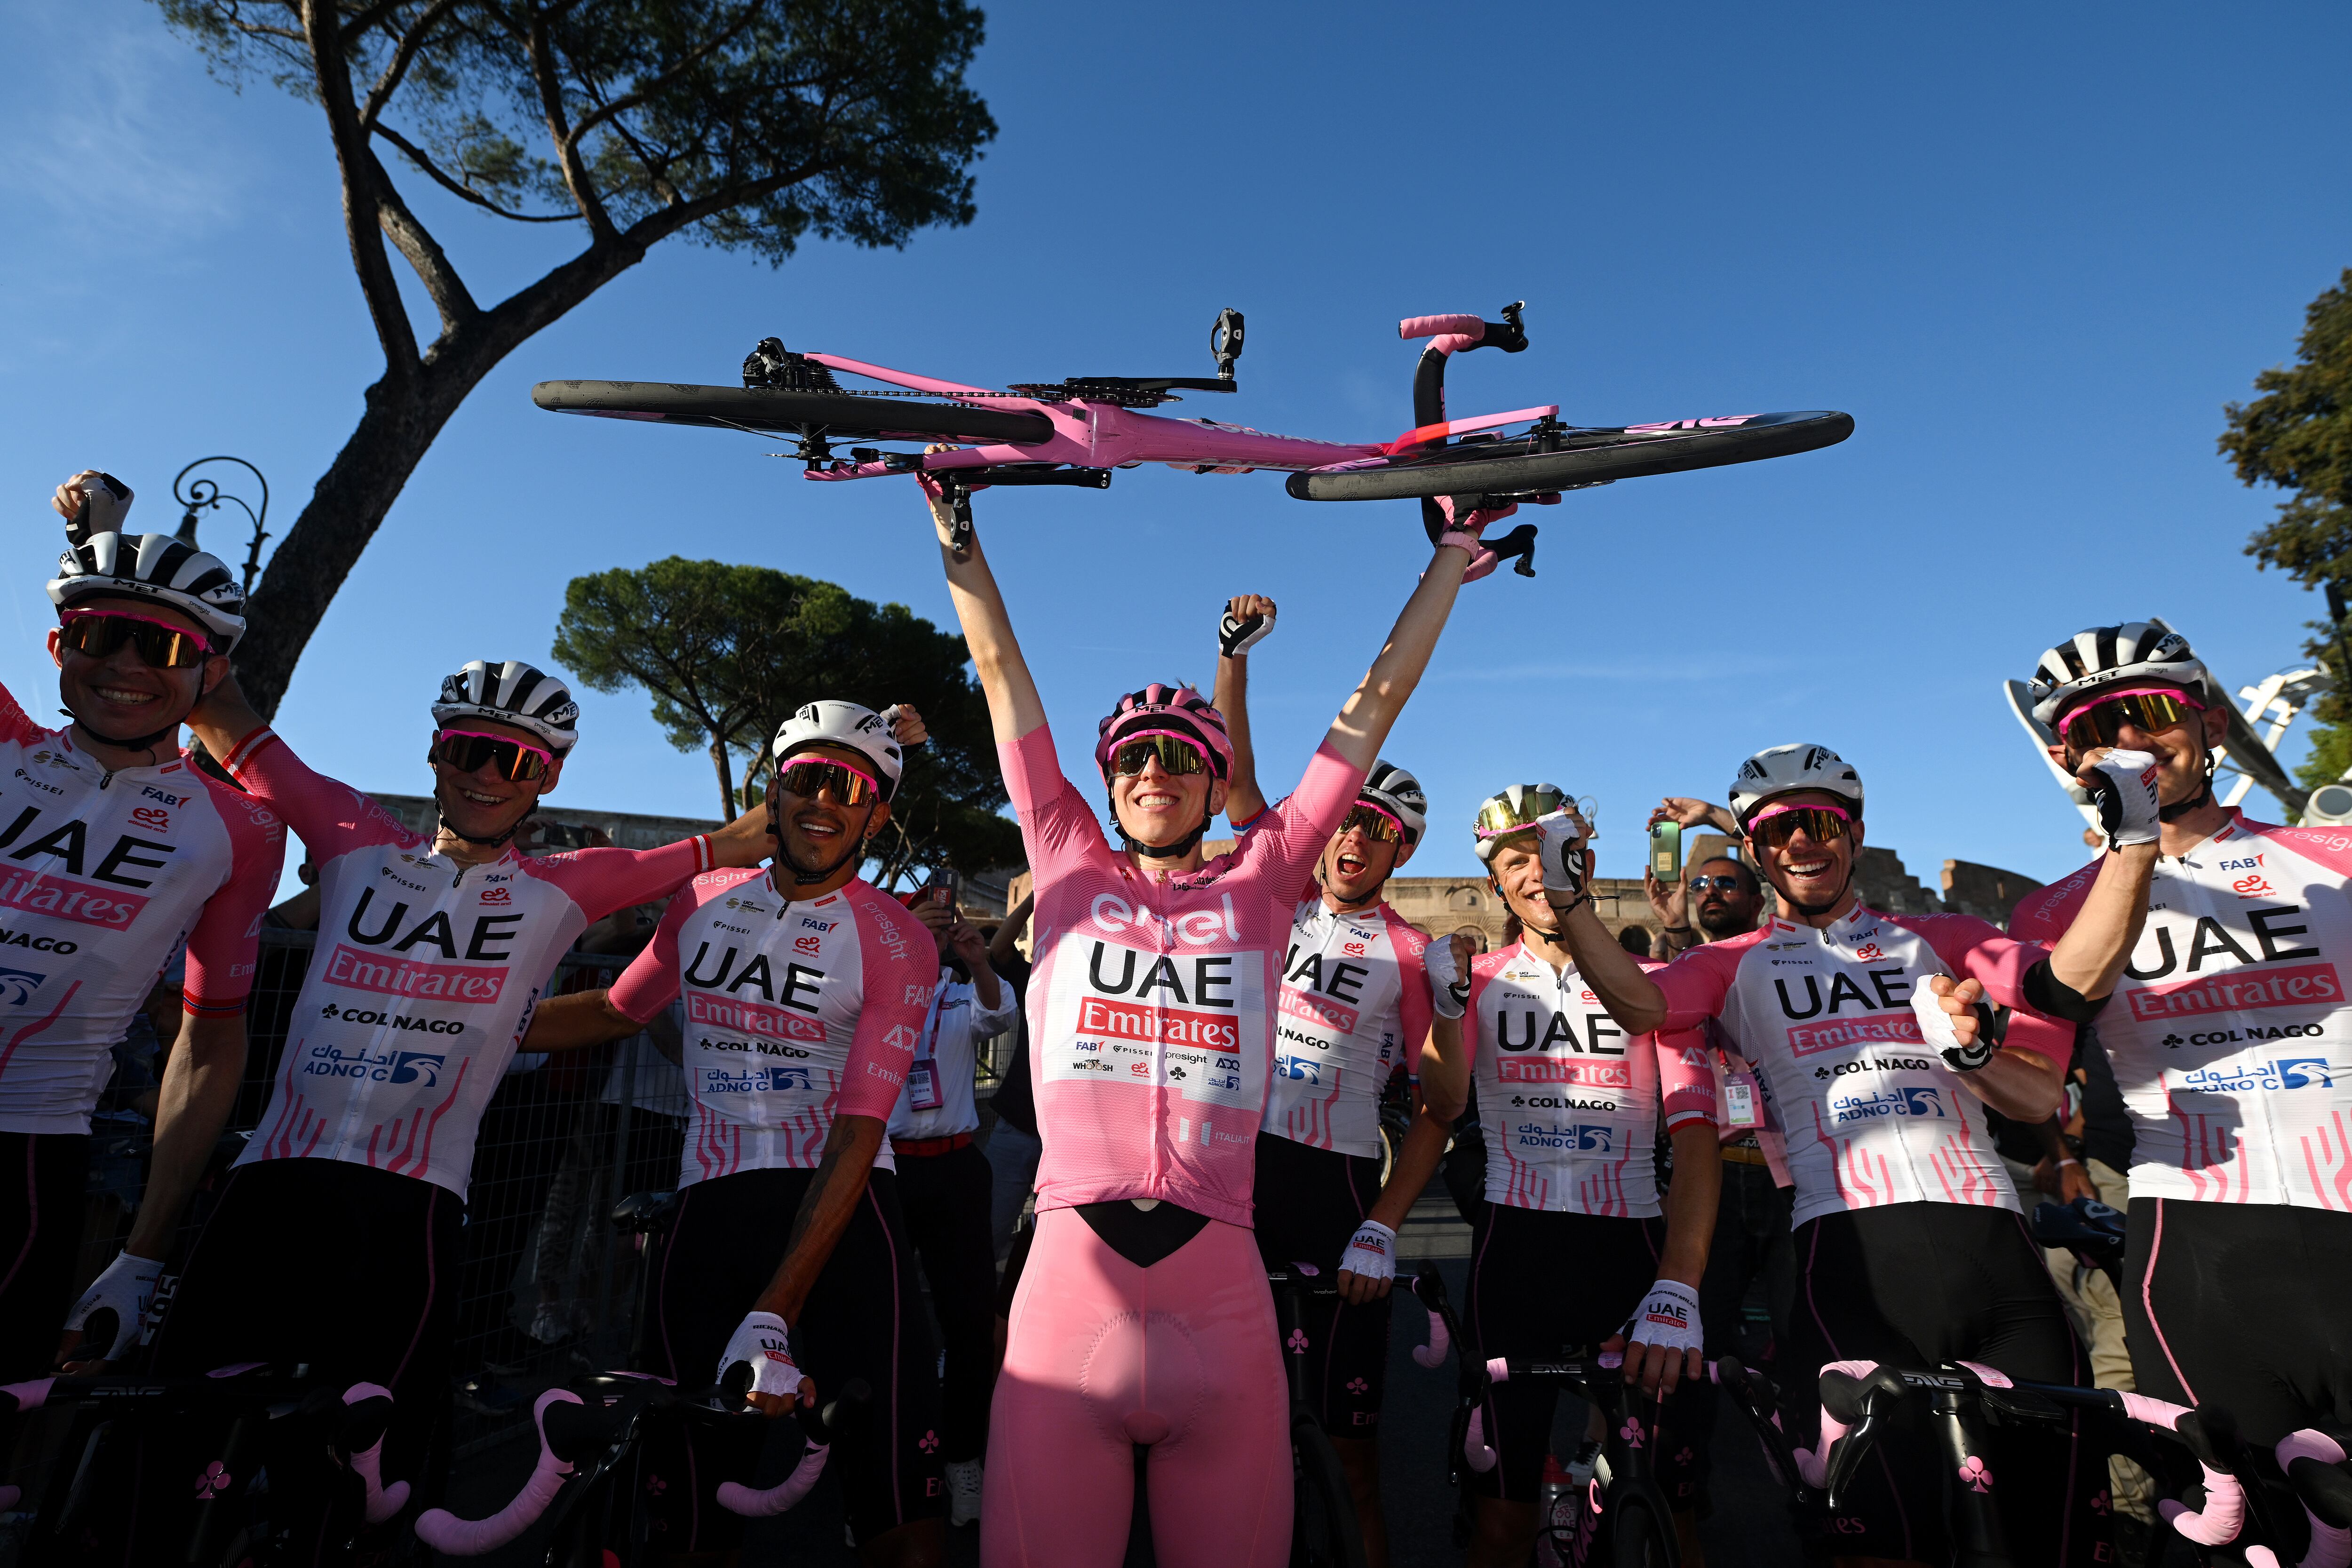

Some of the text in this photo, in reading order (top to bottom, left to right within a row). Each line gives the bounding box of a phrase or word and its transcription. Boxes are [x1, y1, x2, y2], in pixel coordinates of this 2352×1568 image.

[113, 578, 164, 595] MET
[188, 599, 211, 616] presight
[2078, 669, 2120, 686] MET
[478, 707, 516, 720] MET
[534, 722, 551, 734] presight
[1743, 760, 1759, 780] MET
[26, 777, 64, 796] PISSEI
[1389, 798, 1402, 810] presight
[2268, 827, 2352, 852] presig
[390, 874, 427, 892] PISSEI
[675, 871, 748, 903] presight
[0, 872, 135, 924] irates
[815, 897, 837, 907] Emirates
[2034, 864, 2098, 923] presight
[348, 885, 524, 961] UAE
[1090, 892, 1240, 946] enel
[721, 923, 750, 935] PISSEI
[861, 901, 908, 961] presight
[1295, 924, 1314, 939] PISSEI
[0, 930, 78, 955] NAGO
[792, 947, 809, 957] etisalat
[2124, 905, 2320, 980] UAE
[330, 948, 501, 1000] Emirates
[684, 941, 826, 1014] UAE
[1089, 940, 1234, 1008] UAE
[1774, 967, 1912, 1020] UAE
[2131, 974, 2336, 1015] Emirates
[691, 996, 821, 1038] Emirates
[1084, 1003, 1235, 1047] Emirates
[1498, 1011, 1625, 1055] UAE
[1123, 1047, 1152, 1056] PISSEI
[1380, 1033, 1393, 1059] FAB
[1165, 1051, 1208, 1065] presight
[1215, 1057, 1240, 1072] ADQ
[1501, 1058, 1627, 1086] Emirates
[1215, 1131, 1250, 1146] ITALIA.IT
[1354, 1242, 1385, 1255] Emirates
[1355, 1235, 1385, 1249] UAE
[1647, 1314, 1687, 1329] Emirates
[1648, 1303, 1688, 1321] UAE
